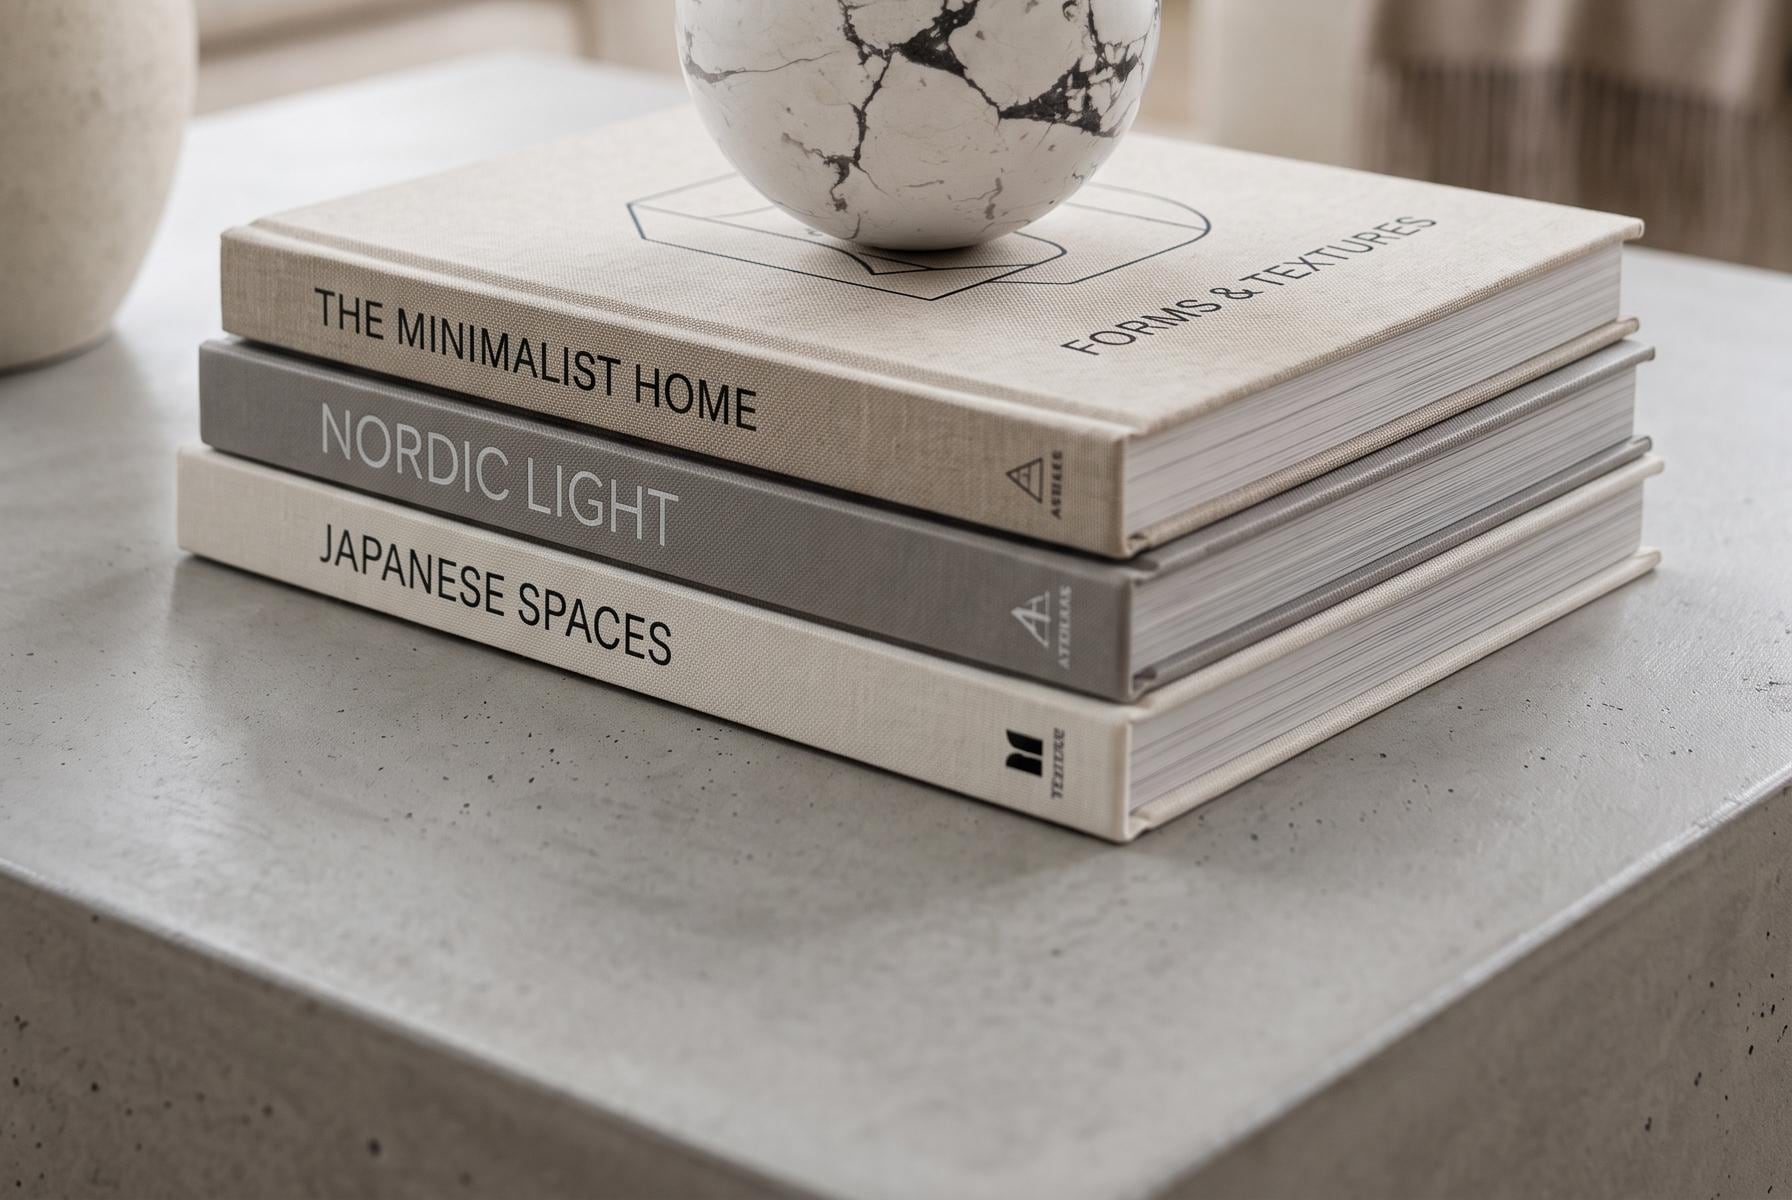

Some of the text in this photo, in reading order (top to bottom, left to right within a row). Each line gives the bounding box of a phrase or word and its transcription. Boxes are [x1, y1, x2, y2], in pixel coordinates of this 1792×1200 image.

[1060, 216, 1437, 356] FORMS & TEXTURES
[314, 287, 757, 431] THE MINIMALIST HOME
[322, 402, 679, 547] NORDIC LIGHT
[320, 524, 672, 667] JAPANESE SPACES
